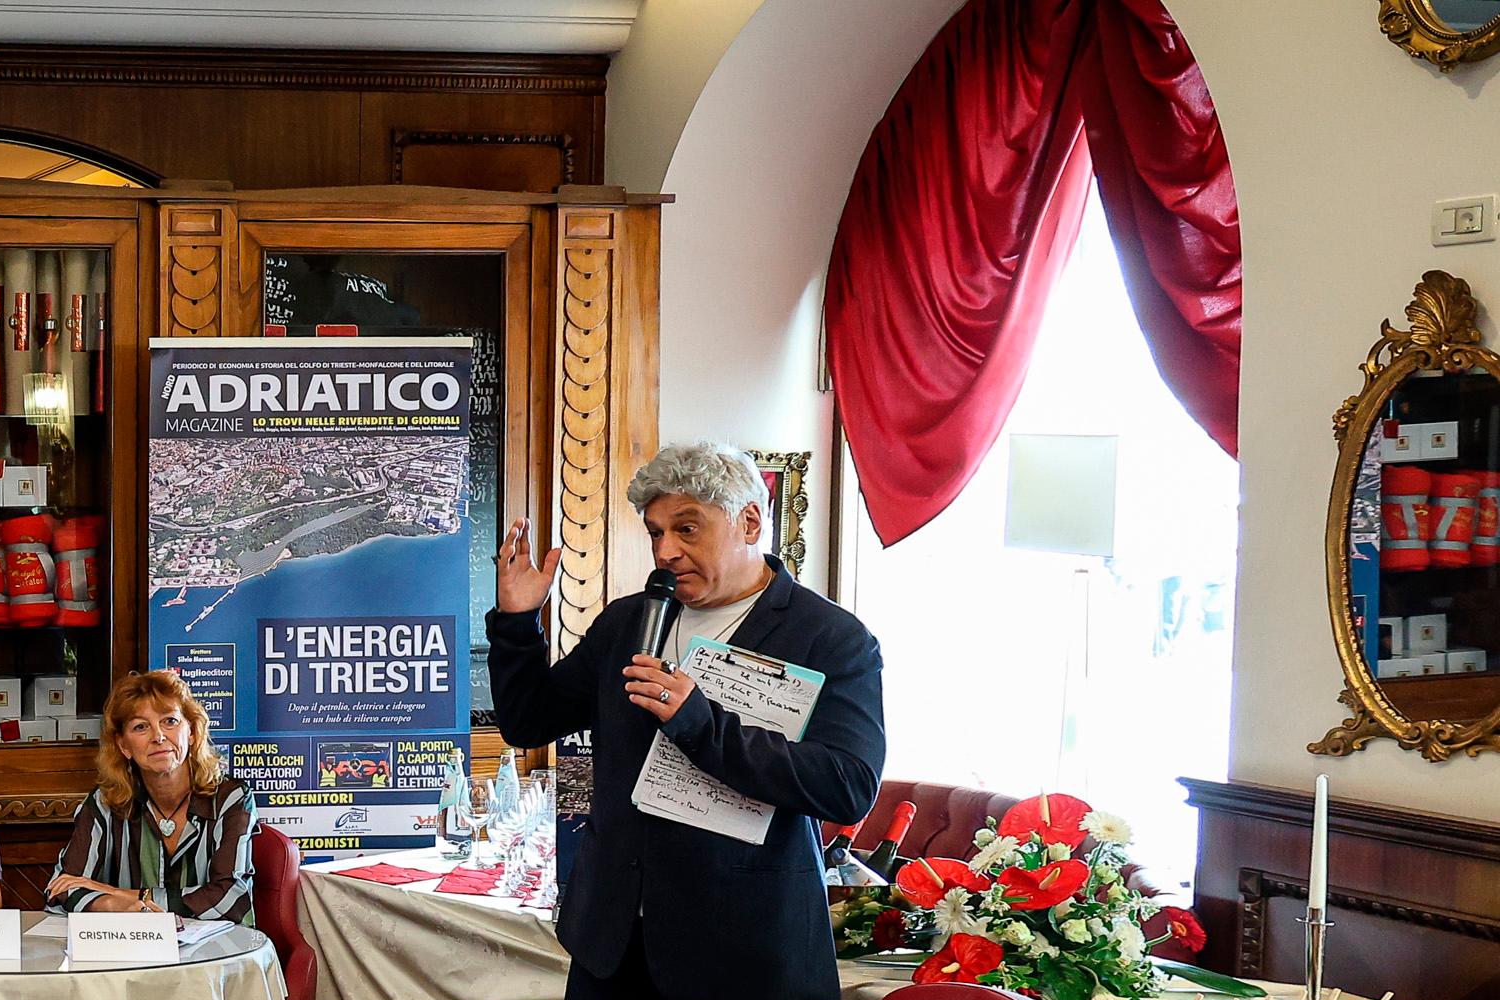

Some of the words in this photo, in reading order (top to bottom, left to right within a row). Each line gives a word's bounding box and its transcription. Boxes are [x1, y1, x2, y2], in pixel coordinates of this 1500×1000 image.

[160, 374, 176, 400] NORD
[166, 372, 460, 413] ADRIATICO
[165, 418, 244, 432] MAGAZINE
[252, 417, 266, 426] LO
[268, 417, 302, 426] TROVI
[305, 416, 335, 426] NELLE
[338, 416, 394, 426] RIVENDITE
[397, 416, 408, 425] DI
[411, 416, 460, 425] GIORNALI
[181, 669, 233, 678] luglioeditore
[264, 662, 299, 695] DI
[308, 660, 449, 694] TRIESTE
[287, 702, 309, 714] Dopo
[311, 702, 318, 711] il
[318, 702, 350, 713] petrolio,
[352, 702, 384, 711] elettrico
[392, 701, 426, 712] idrogeno
[301, 715, 311, 724] in
[325, 714, 342, 723] hub
[342, 714, 352, 723] di
[353, 714, 379, 722] rilievo
[380, 716, 412, 724] europeo
[233, 744, 279, 755] CAMPUS
[397, 741, 419, 752] DAL
[420, 740, 454, 752] PORTO
[233, 756, 245, 767] DI
[248, 756, 264, 767] VIA
[266, 755, 304, 766] LOCCHI
[397, 754, 405, 764] A
[407, 753, 436, 764] CAPO
[233, 767, 302, 779] RICREATORIO
[397, 765, 420, 776] CON
[421, 765, 436, 776] UN
[255, 779, 297, 790] FUTURO
[397, 777, 445, 788] ELETTRIC
[268, 793, 354, 805] SOSTENITORI
[78, 930, 127, 941] CRISTINA
[129, 931, 164, 941] SERRA
